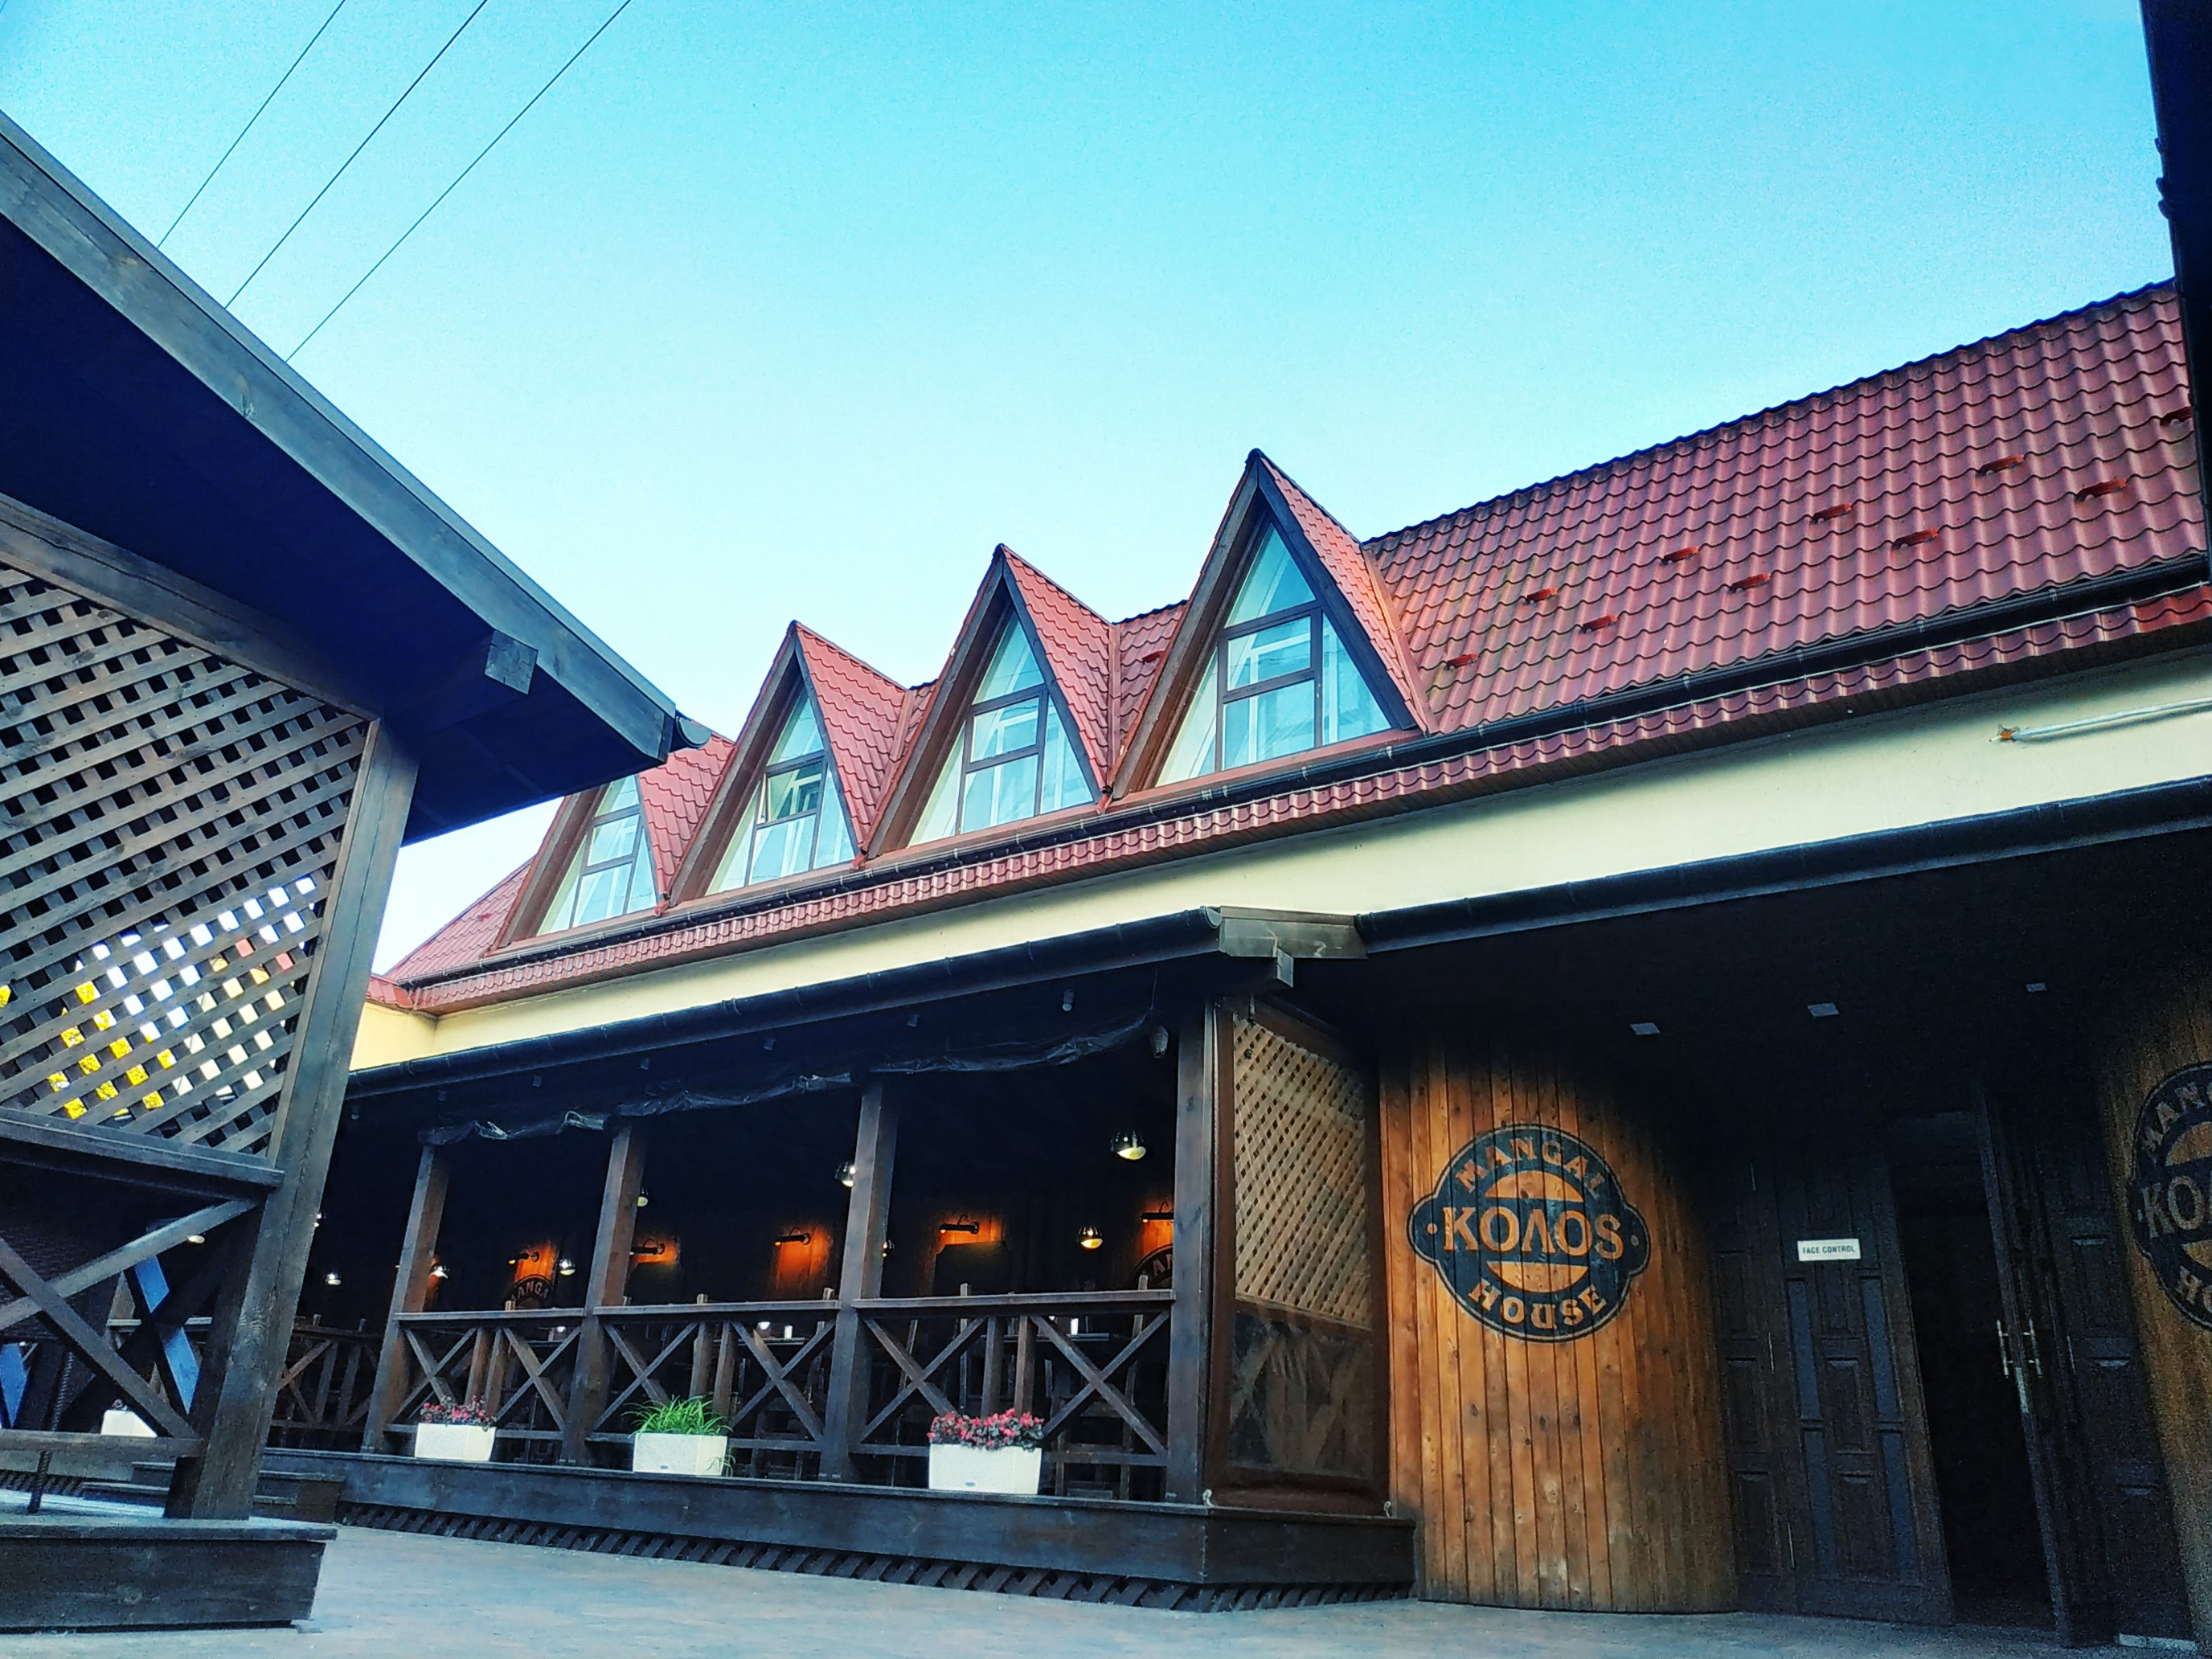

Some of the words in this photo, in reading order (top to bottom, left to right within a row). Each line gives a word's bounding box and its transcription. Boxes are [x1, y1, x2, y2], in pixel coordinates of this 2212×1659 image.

[1802, 1246, 1820, 1254] FACE
[1822, 1245, 1856, 1254] CONTROL
[1468, 1278, 1607, 1329] HOUSE
